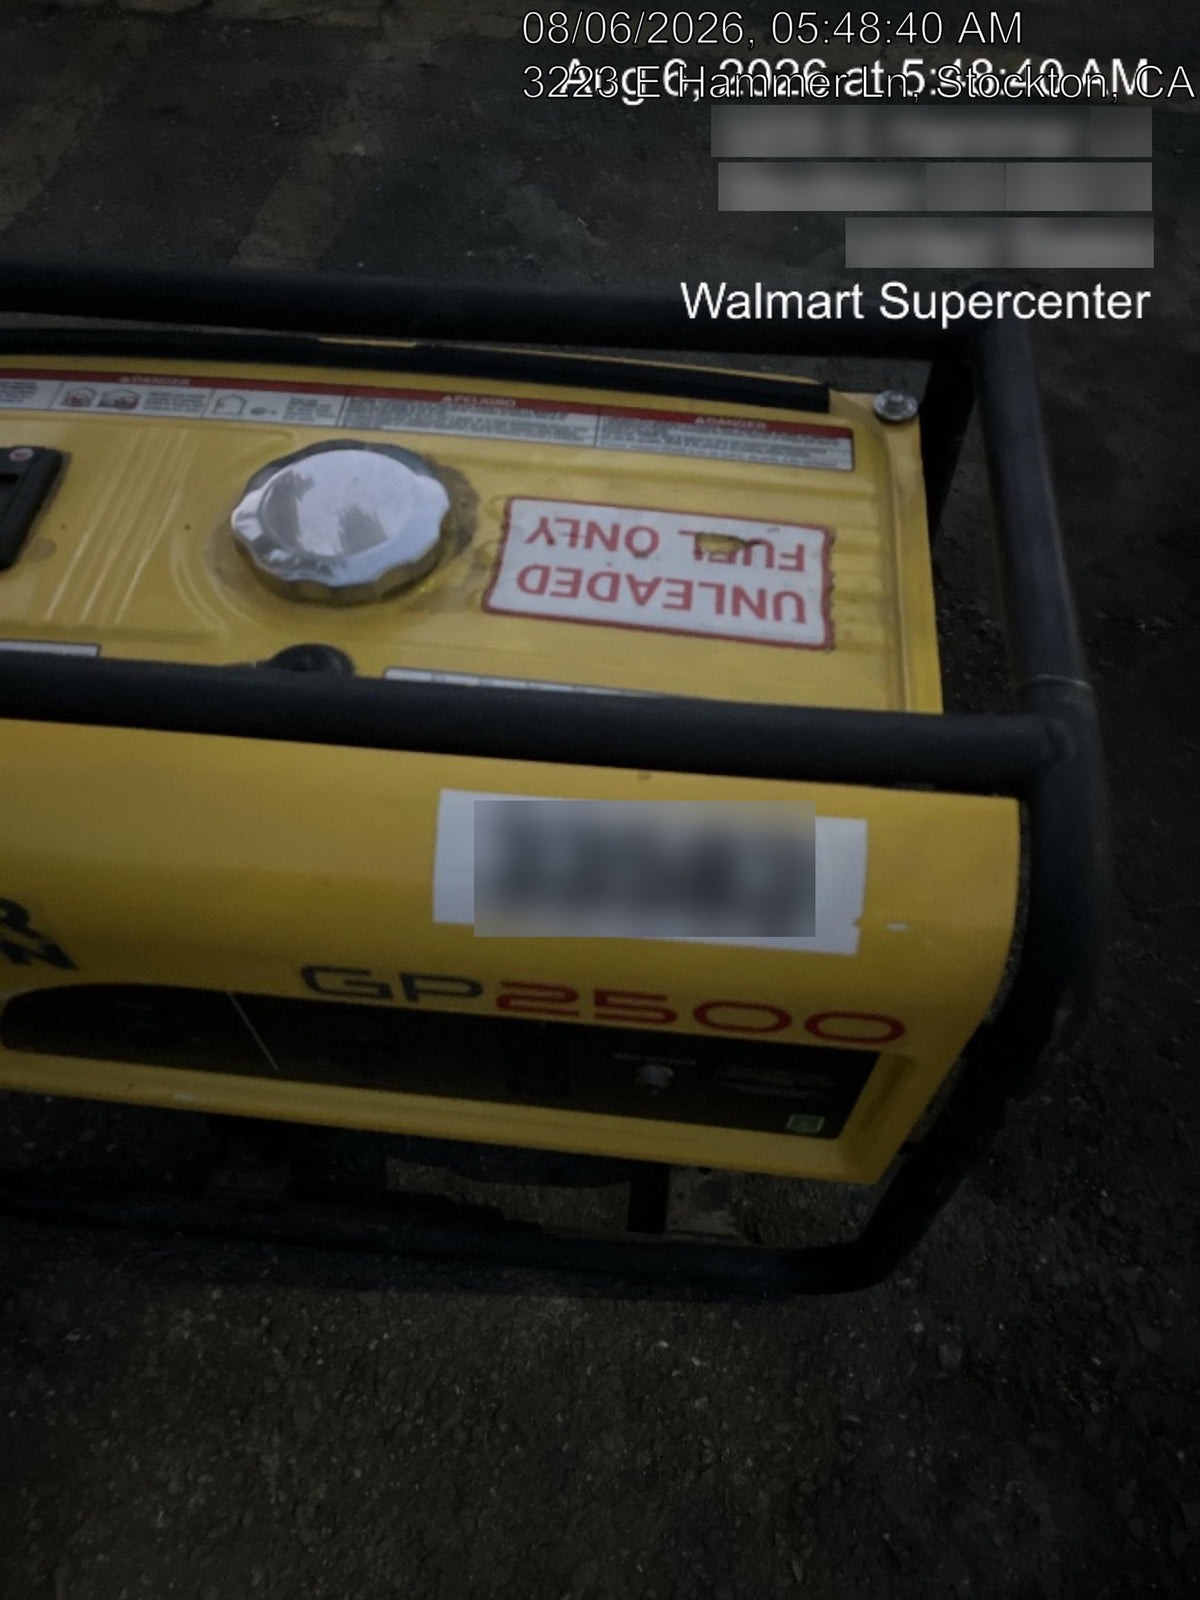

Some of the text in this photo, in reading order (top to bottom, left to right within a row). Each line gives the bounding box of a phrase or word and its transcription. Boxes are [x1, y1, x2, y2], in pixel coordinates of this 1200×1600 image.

[525, 516, 660, 559] ONLY
[516, 563, 806, 623] UNLEADED
[300, 965, 906, 1045] GP2500
